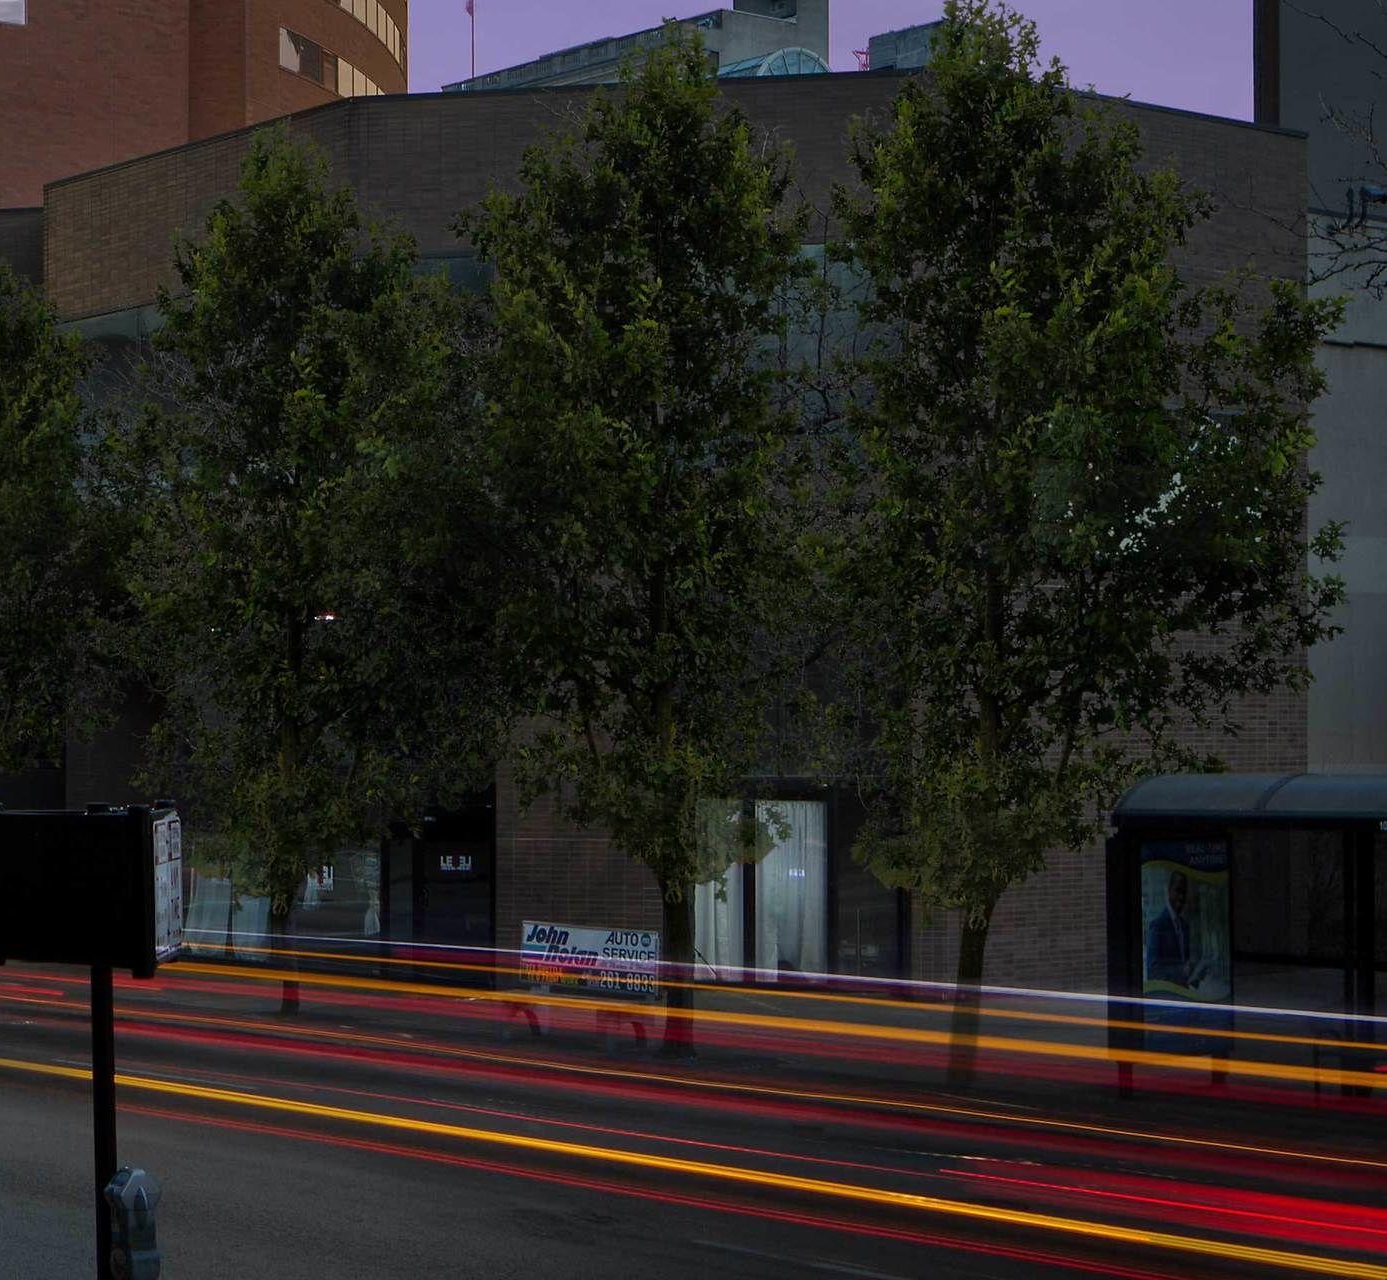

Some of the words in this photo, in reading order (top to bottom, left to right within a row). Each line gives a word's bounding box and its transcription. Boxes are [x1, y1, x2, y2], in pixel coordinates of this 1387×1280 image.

[526, 924, 570, 945] John
[605, 931, 639, 946] AUTO
[602, 947, 656, 961] SERVICE
